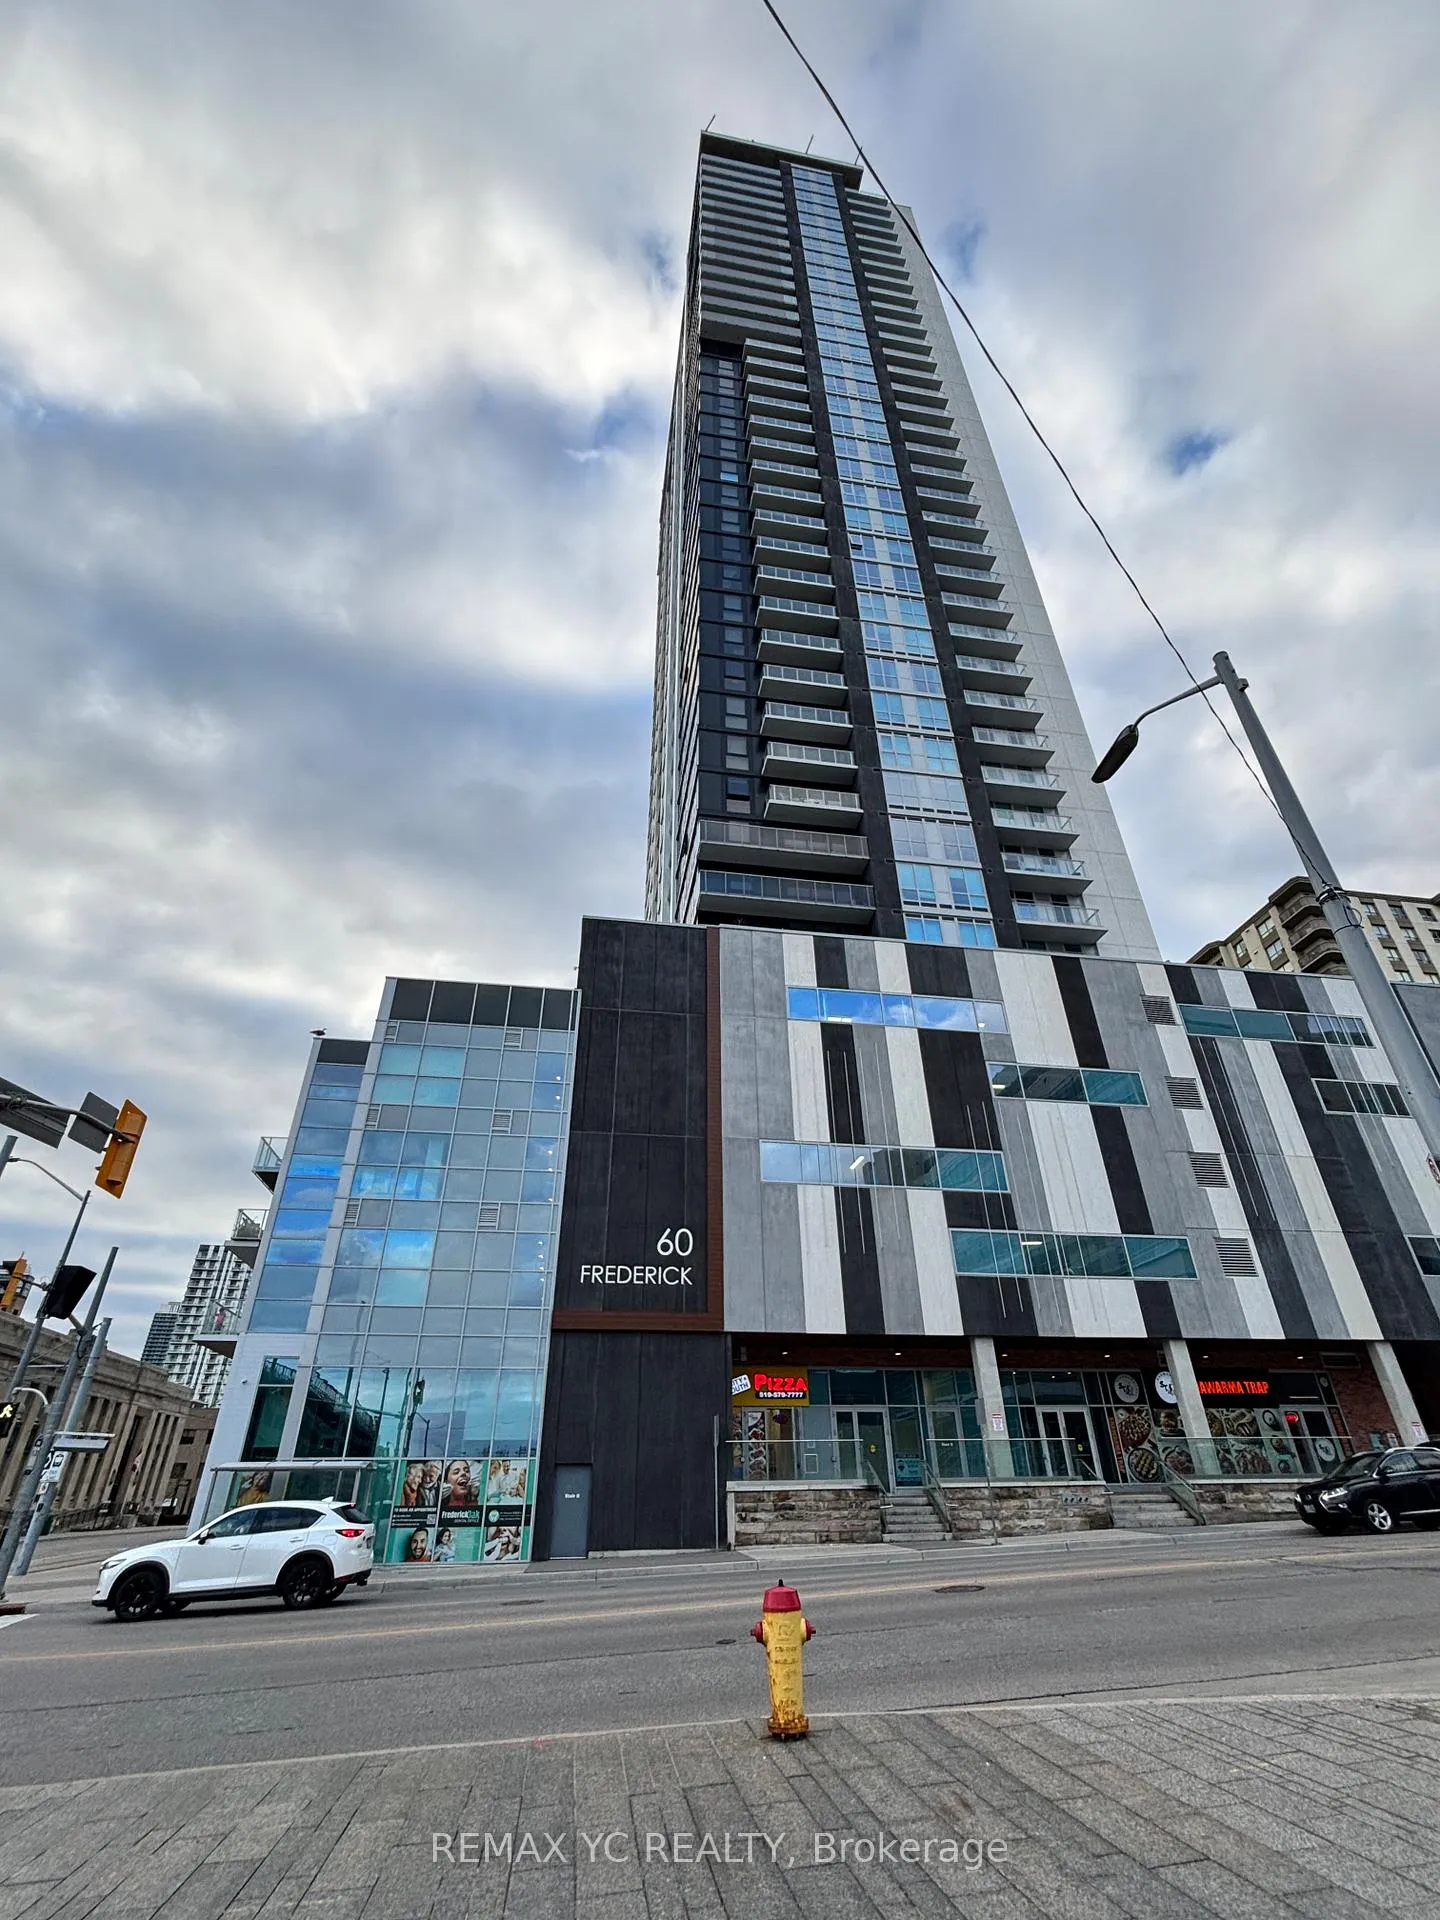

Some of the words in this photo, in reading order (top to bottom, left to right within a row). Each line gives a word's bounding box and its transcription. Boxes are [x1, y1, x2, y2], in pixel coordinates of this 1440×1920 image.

[657, 1228, 693, 1256] 60
[580, 1265, 693, 1285] FREDERICK
[1244, 1381, 1269, 1394] TRAP
